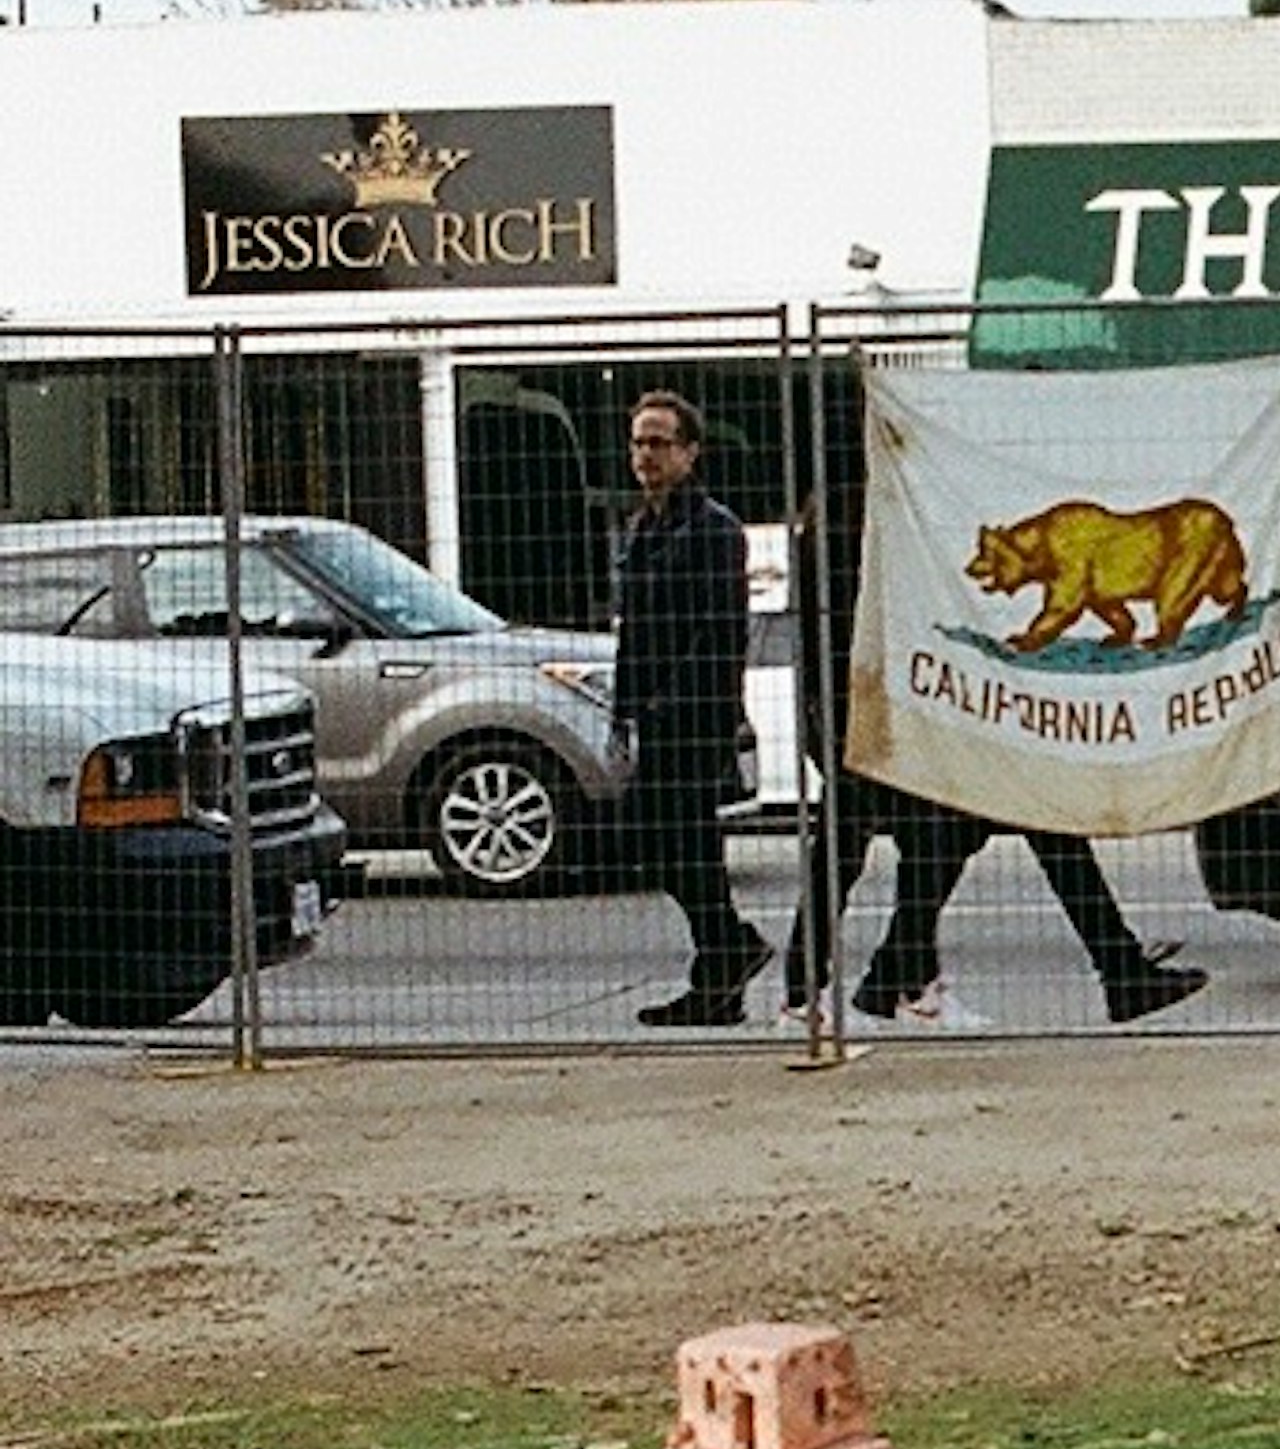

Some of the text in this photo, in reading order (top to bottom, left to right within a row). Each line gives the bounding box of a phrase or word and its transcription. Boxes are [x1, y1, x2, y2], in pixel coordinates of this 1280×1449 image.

[200, 198, 595, 290] JESSICA RICH
[910, 650, 1137, 745] CALIFORNIA
